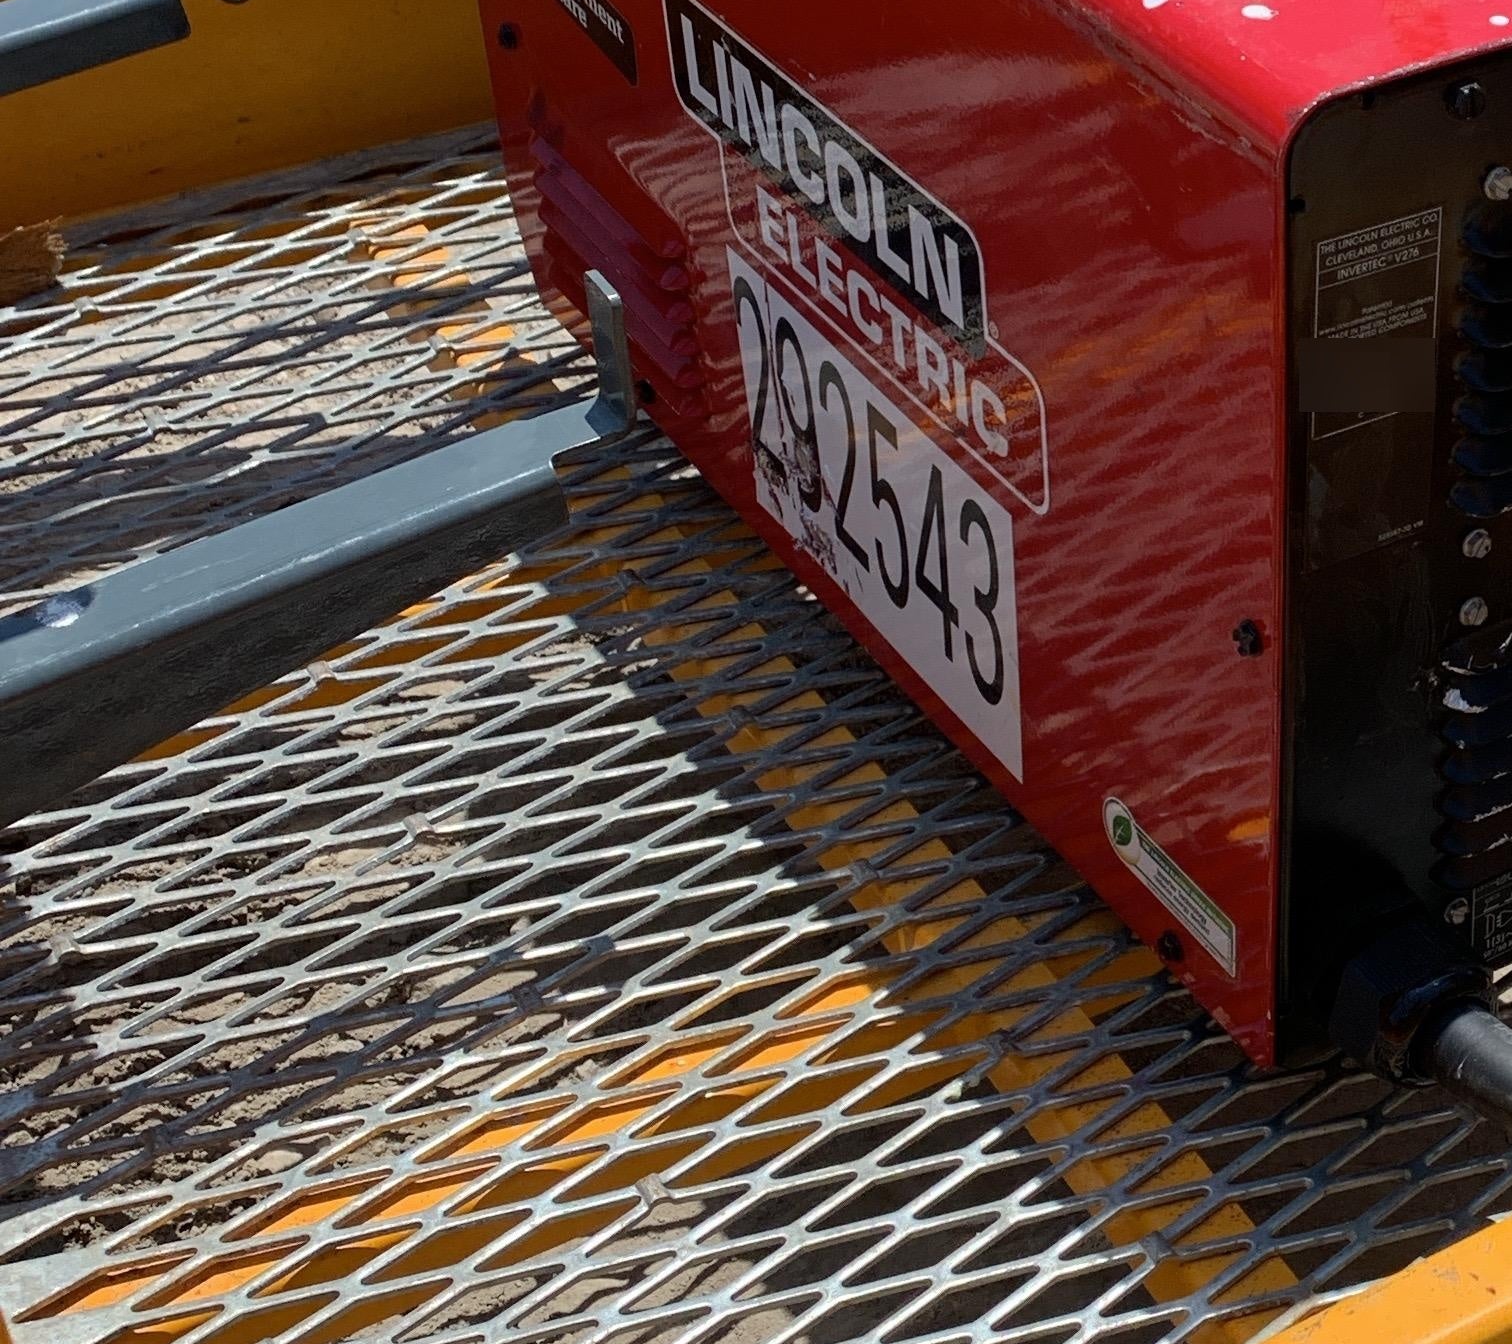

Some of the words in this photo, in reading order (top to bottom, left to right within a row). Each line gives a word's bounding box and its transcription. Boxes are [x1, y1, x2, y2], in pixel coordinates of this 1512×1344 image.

[680, 11, 965, 331] LINCOLN
[1320, 242, 1337, 255] THE
[1338, 230, 1378, 250] LINCOLN
[1380, 217, 1420, 237] ELECTRIC
[1381, 237, 1406, 250] OHIO
[756, 184, 1009, 457] ELECTRIC
[1394, 247, 1420, 263] V276
[734, 275, 1005, 707] 292543
